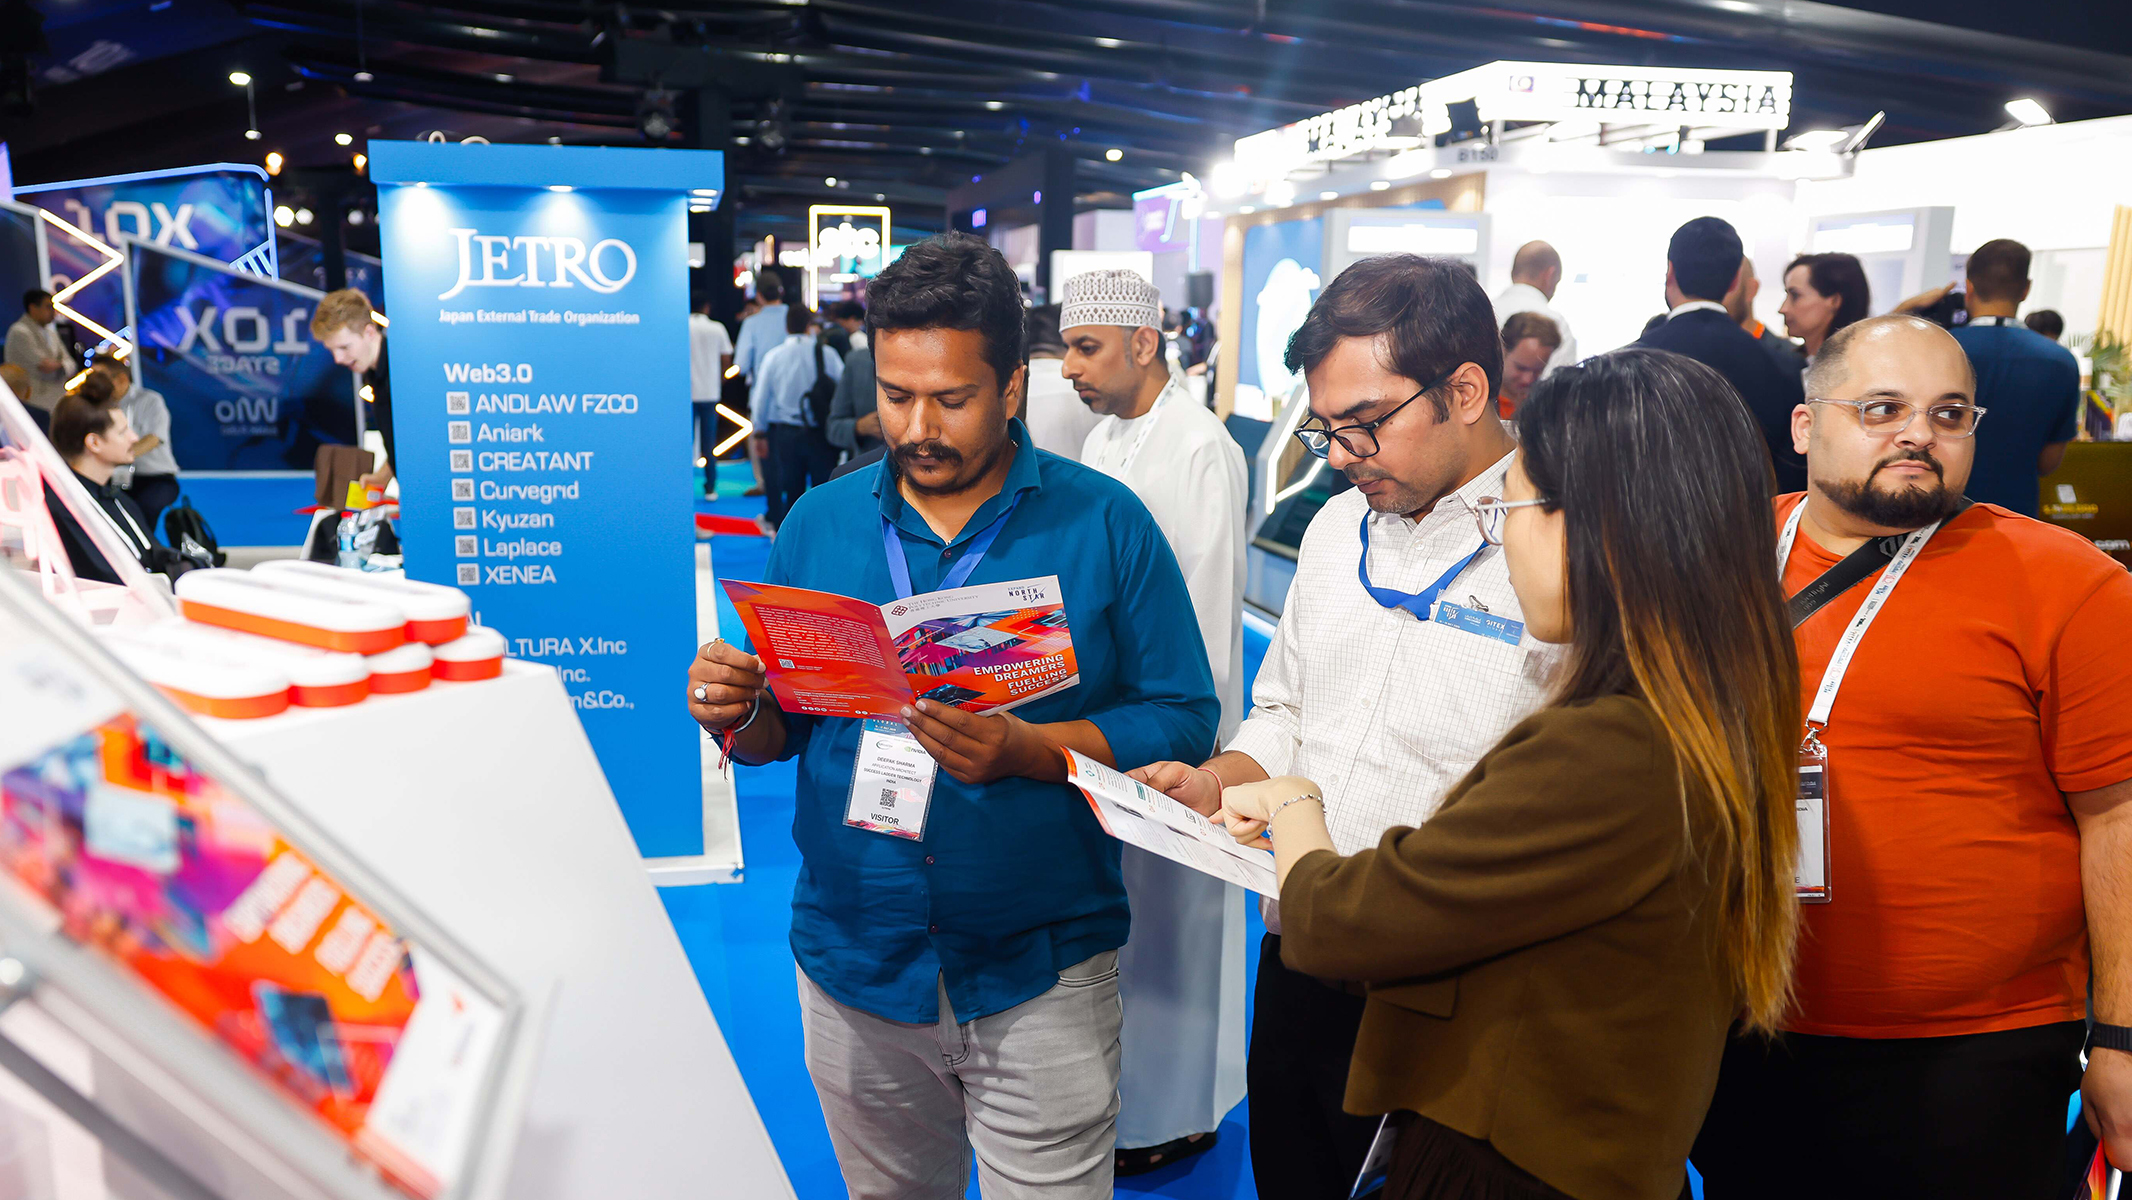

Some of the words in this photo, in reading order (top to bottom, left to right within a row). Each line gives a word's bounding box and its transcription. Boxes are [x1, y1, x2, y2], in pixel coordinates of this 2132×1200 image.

[1577, 78, 1778, 115] MALAYSIA
[438, 227, 638, 300] JETRO
[439, 309, 474, 325] Japan
[477, 309, 526, 323] External
[528, 310, 561, 324] Trade
[564, 310, 640, 326] Organization
[443, 363, 533, 383] Web3.0
[475, 393, 577, 414] ANDLAW
[582, 393, 638, 414] FZCO
[477, 423, 544, 442] Aniark
[478, 451, 594, 471] CREATANT
[480, 480, 579, 504] Curvegrid
[482, 509, 554, 532] Kyuzan
[484, 538, 562, 560] Laplace
[485, 565, 557, 584] XENEA
[1009, 588, 1037, 597] NORTH
[1023, 592, 1045, 601] STAR
[503, 637, 575, 657] LTURA
[973, 654, 1064, 675] EMPOWERING
[994, 661, 1065, 682] DREAMERS
[1007, 669, 1067, 689] FUELLING
[1010, 674, 1068, 696] SUCCESS
[870, 813, 899, 825] VISITOR
